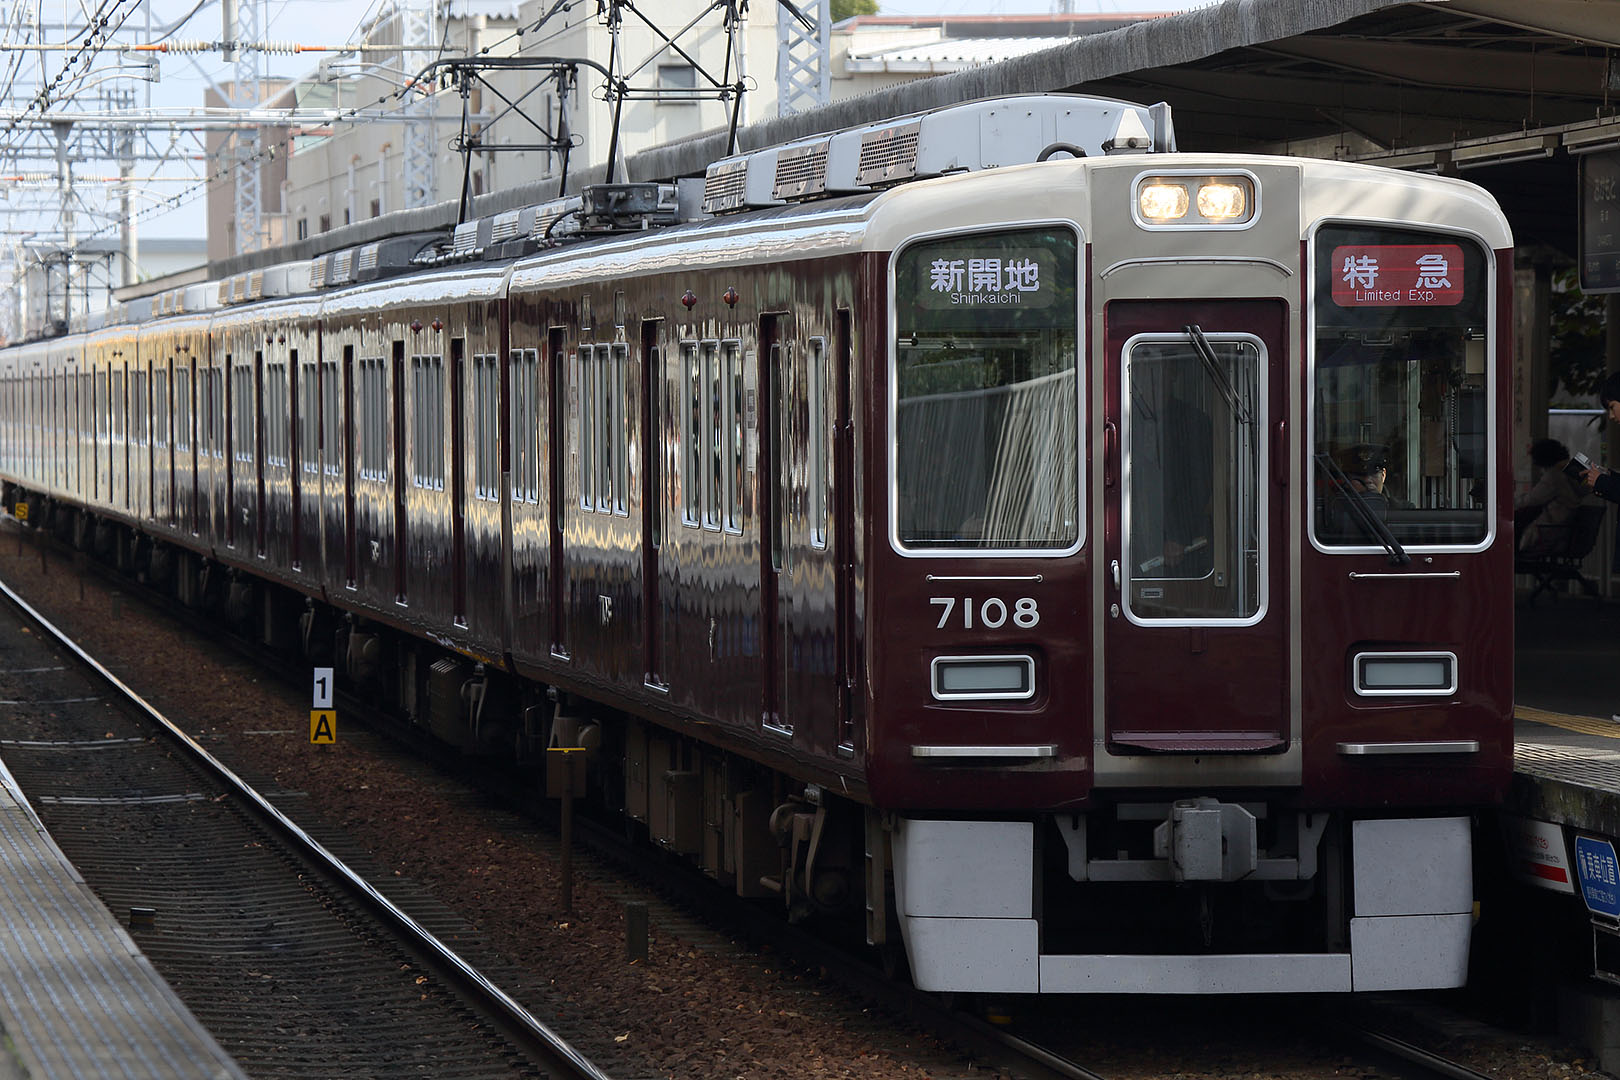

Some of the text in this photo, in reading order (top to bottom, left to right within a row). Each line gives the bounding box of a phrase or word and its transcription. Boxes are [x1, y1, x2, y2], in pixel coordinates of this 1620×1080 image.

[930, 258, 1040, 292] 新開地
[1342, 254, 1451, 289] 特急
[950, 292, 1021, 304] Shinkaichi
[1356, 289, 1437, 302] Limited Exp.
[929, 597, 1040, 628] 7108
[316, 677, 326, 699] 1
[313, 714, 333, 741] A
